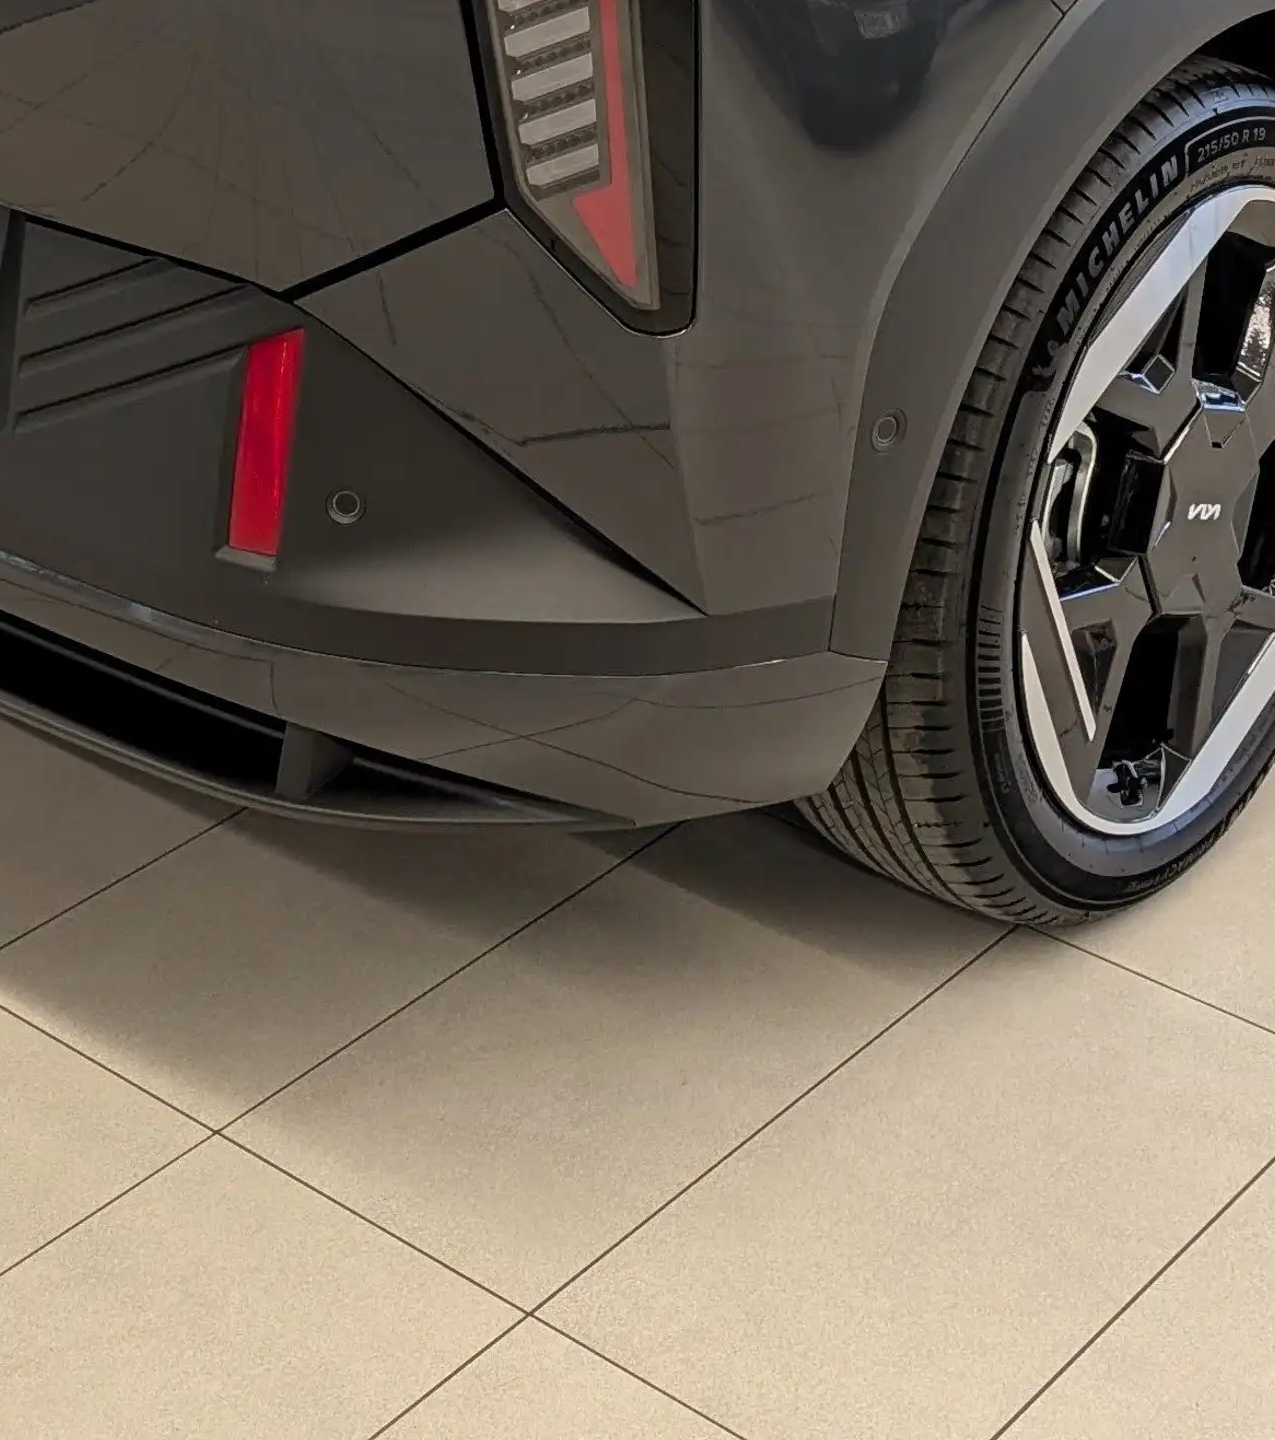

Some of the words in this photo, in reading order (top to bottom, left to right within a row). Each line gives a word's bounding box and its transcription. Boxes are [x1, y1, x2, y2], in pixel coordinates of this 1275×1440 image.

[1197, 130, 1239, 163] 215/50
[1242, 129, 1251, 143] R
[1253, 127, 1267, 142] 19
[1056, 155, 1179, 337] MICHELIN
